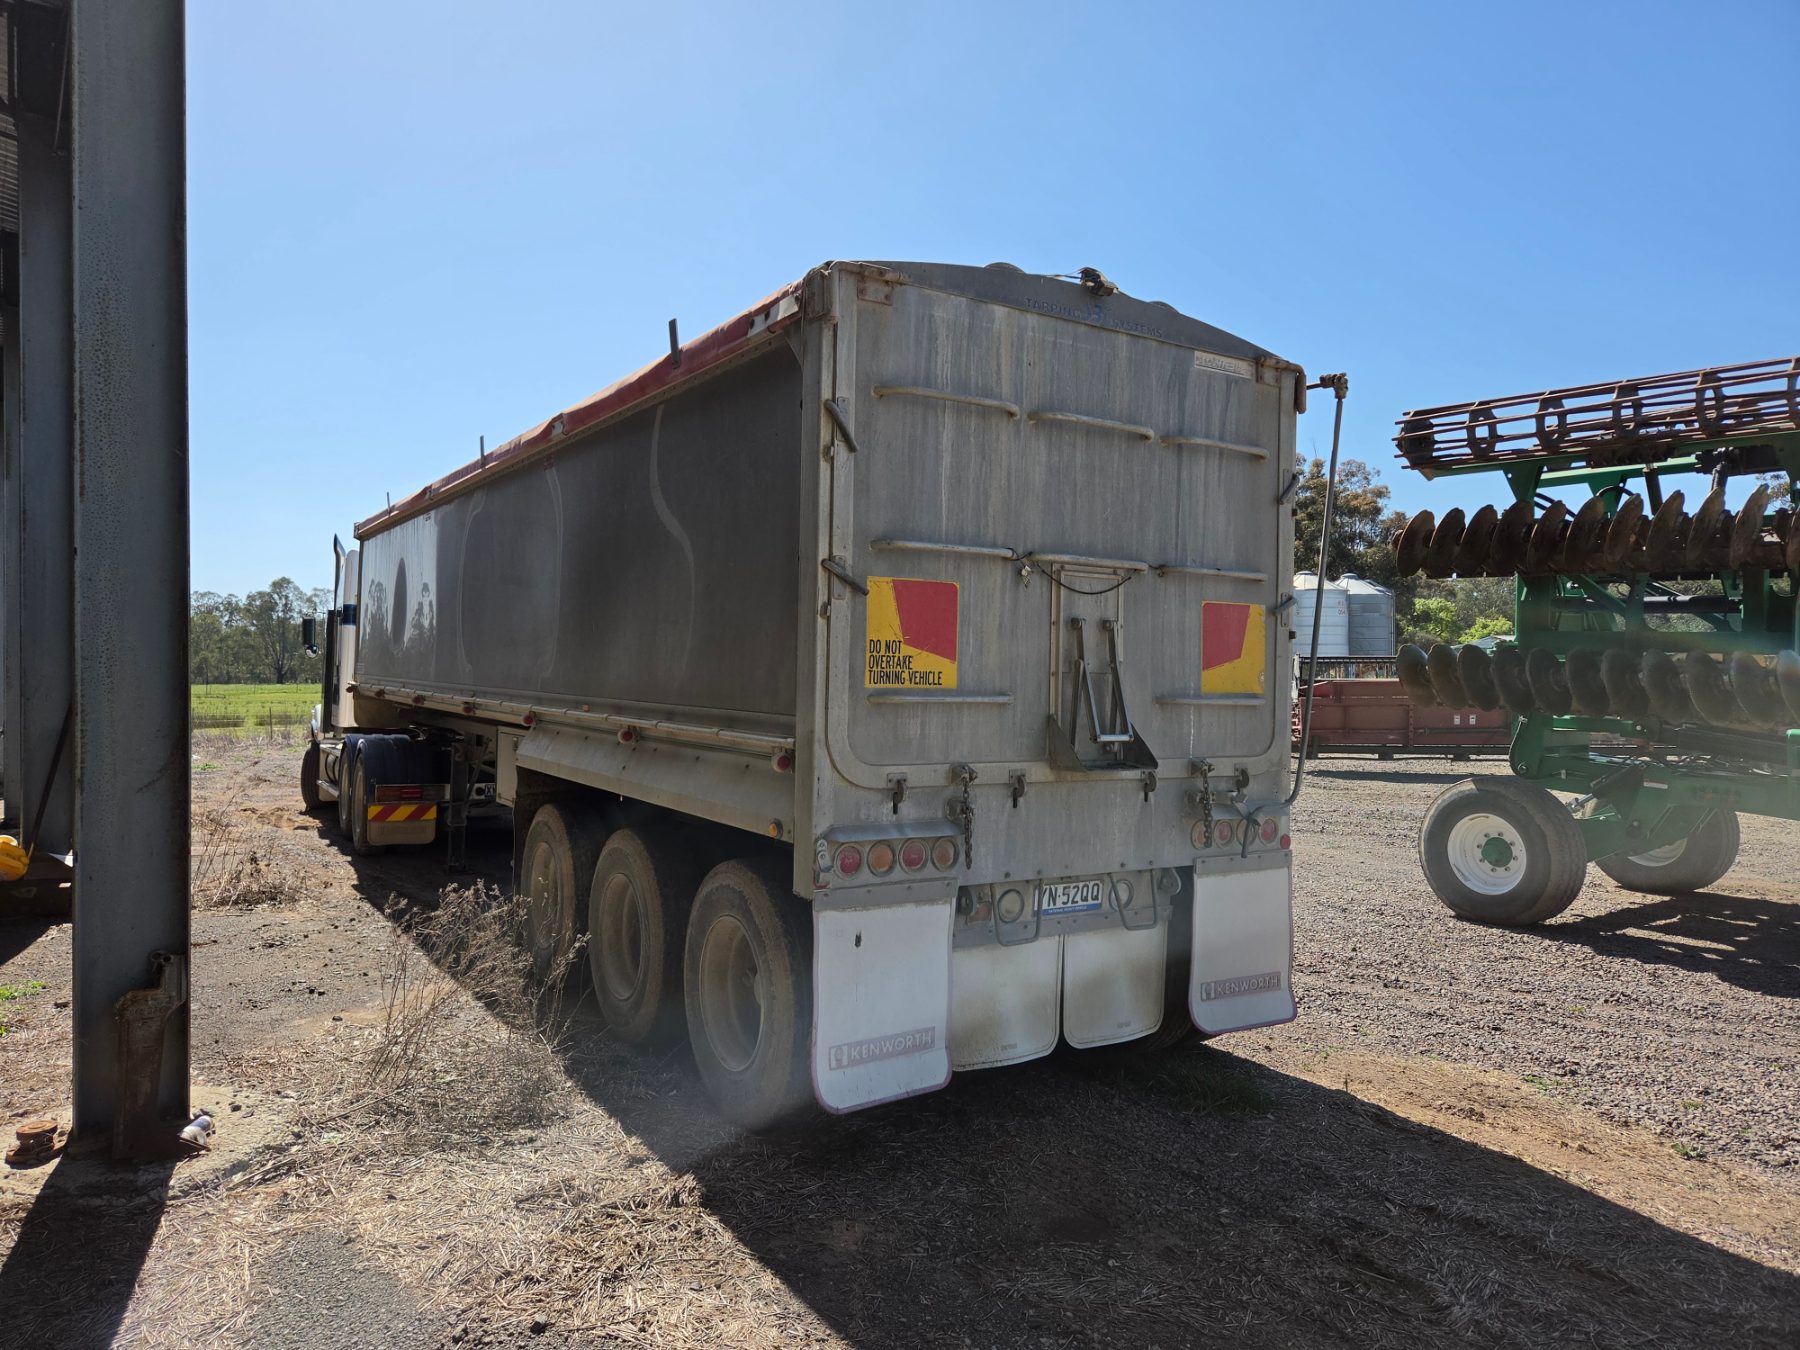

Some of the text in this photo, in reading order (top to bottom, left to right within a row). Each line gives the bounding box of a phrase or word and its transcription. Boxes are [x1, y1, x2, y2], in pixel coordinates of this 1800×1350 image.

[869, 639, 902, 654] DO NOT
[868, 654, 913, 670] OVERTAKE
[868, 670, 943, 686] TURNING VEHICLE
[1217, 975, 1279, 994] KENWORTH
[851, 1030, 932, 1060] KENWORTH
